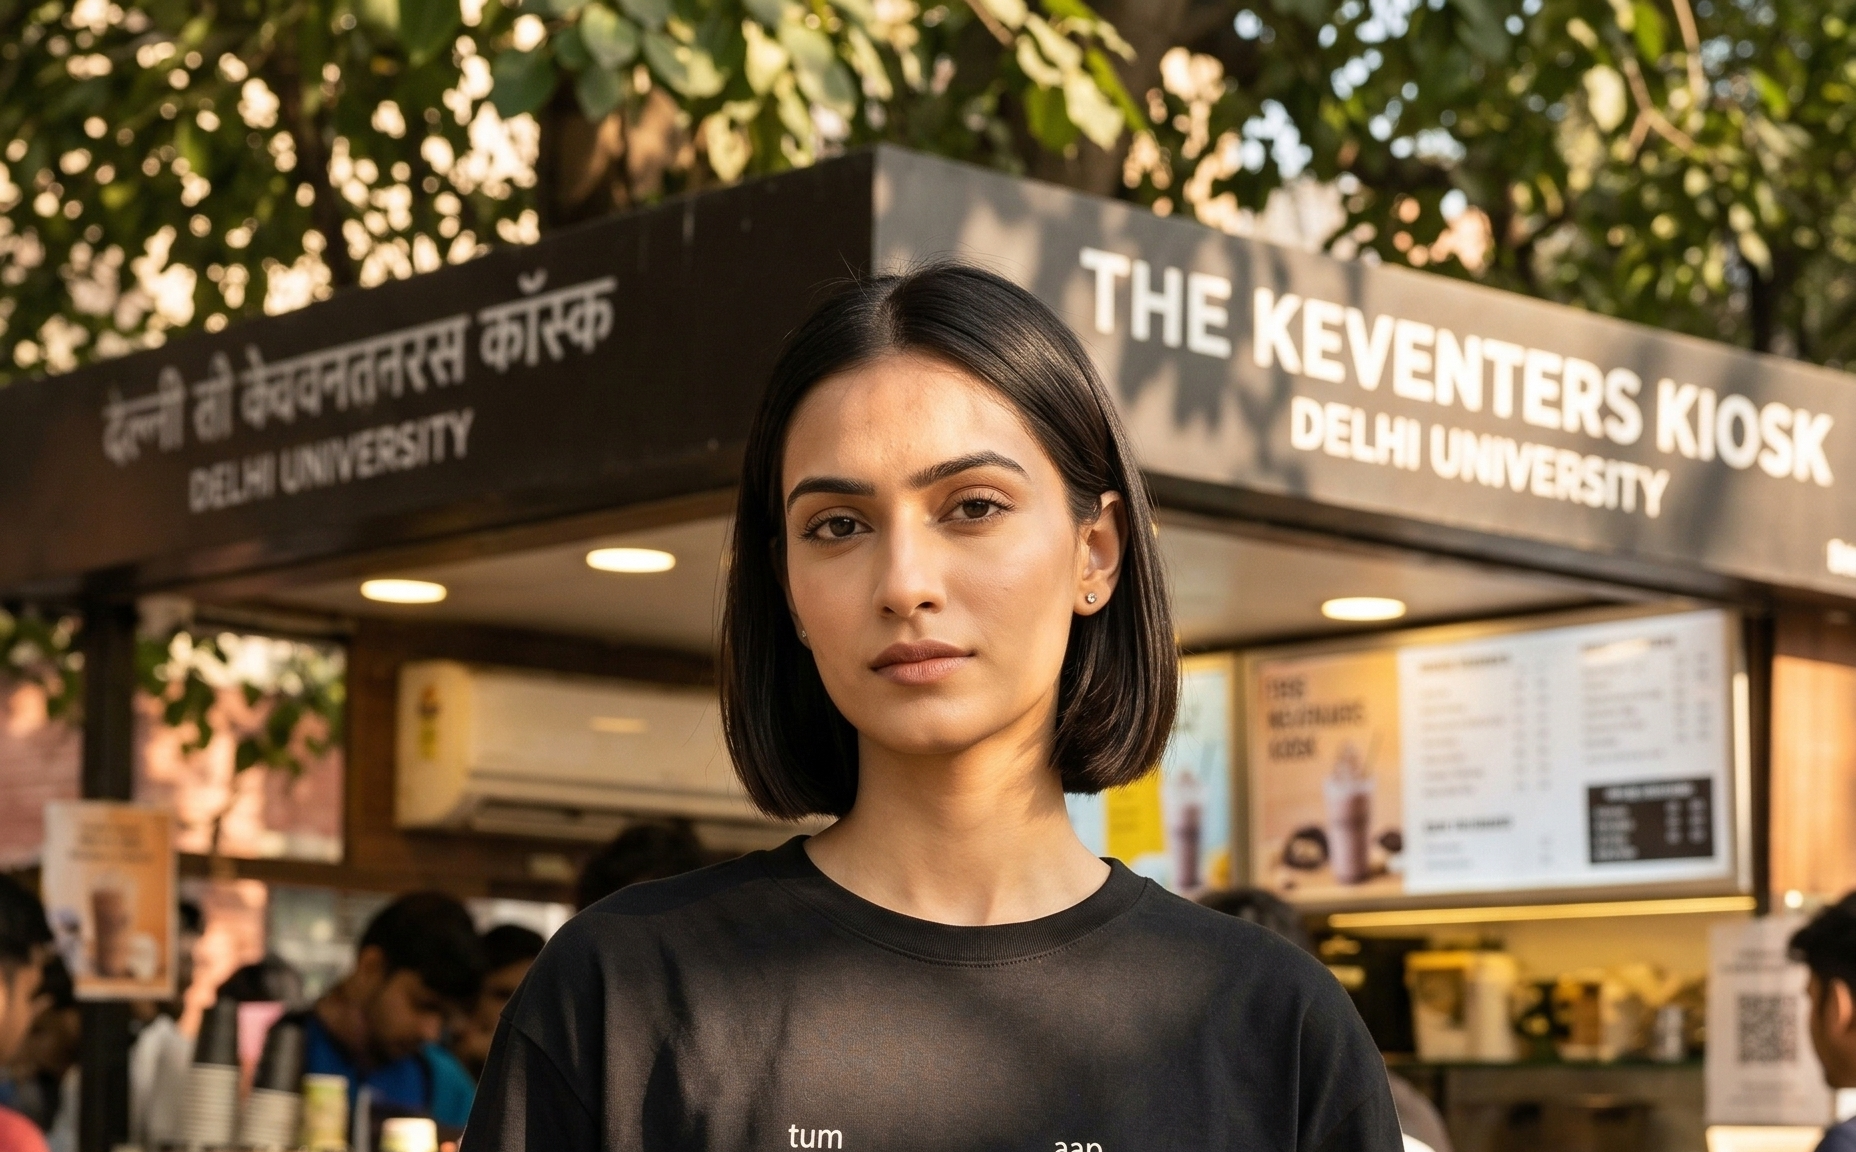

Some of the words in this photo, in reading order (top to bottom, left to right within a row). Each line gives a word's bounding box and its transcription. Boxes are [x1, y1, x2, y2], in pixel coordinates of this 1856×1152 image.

[1081, 248, 1232, 357] THE
[1252, 285, 1644, 446] KEVENTERS
[1655, 377, 1835, 488] KIOSK
[188, 453, 276, 513] DELHI
[279, 406, 475, 495] UNIVERSITY
[1289, 395, 1421, 472] DELHI
[1429, 422, 1671, 517] UNIVERSITY
[788, 1123, 843, 1150] tum
